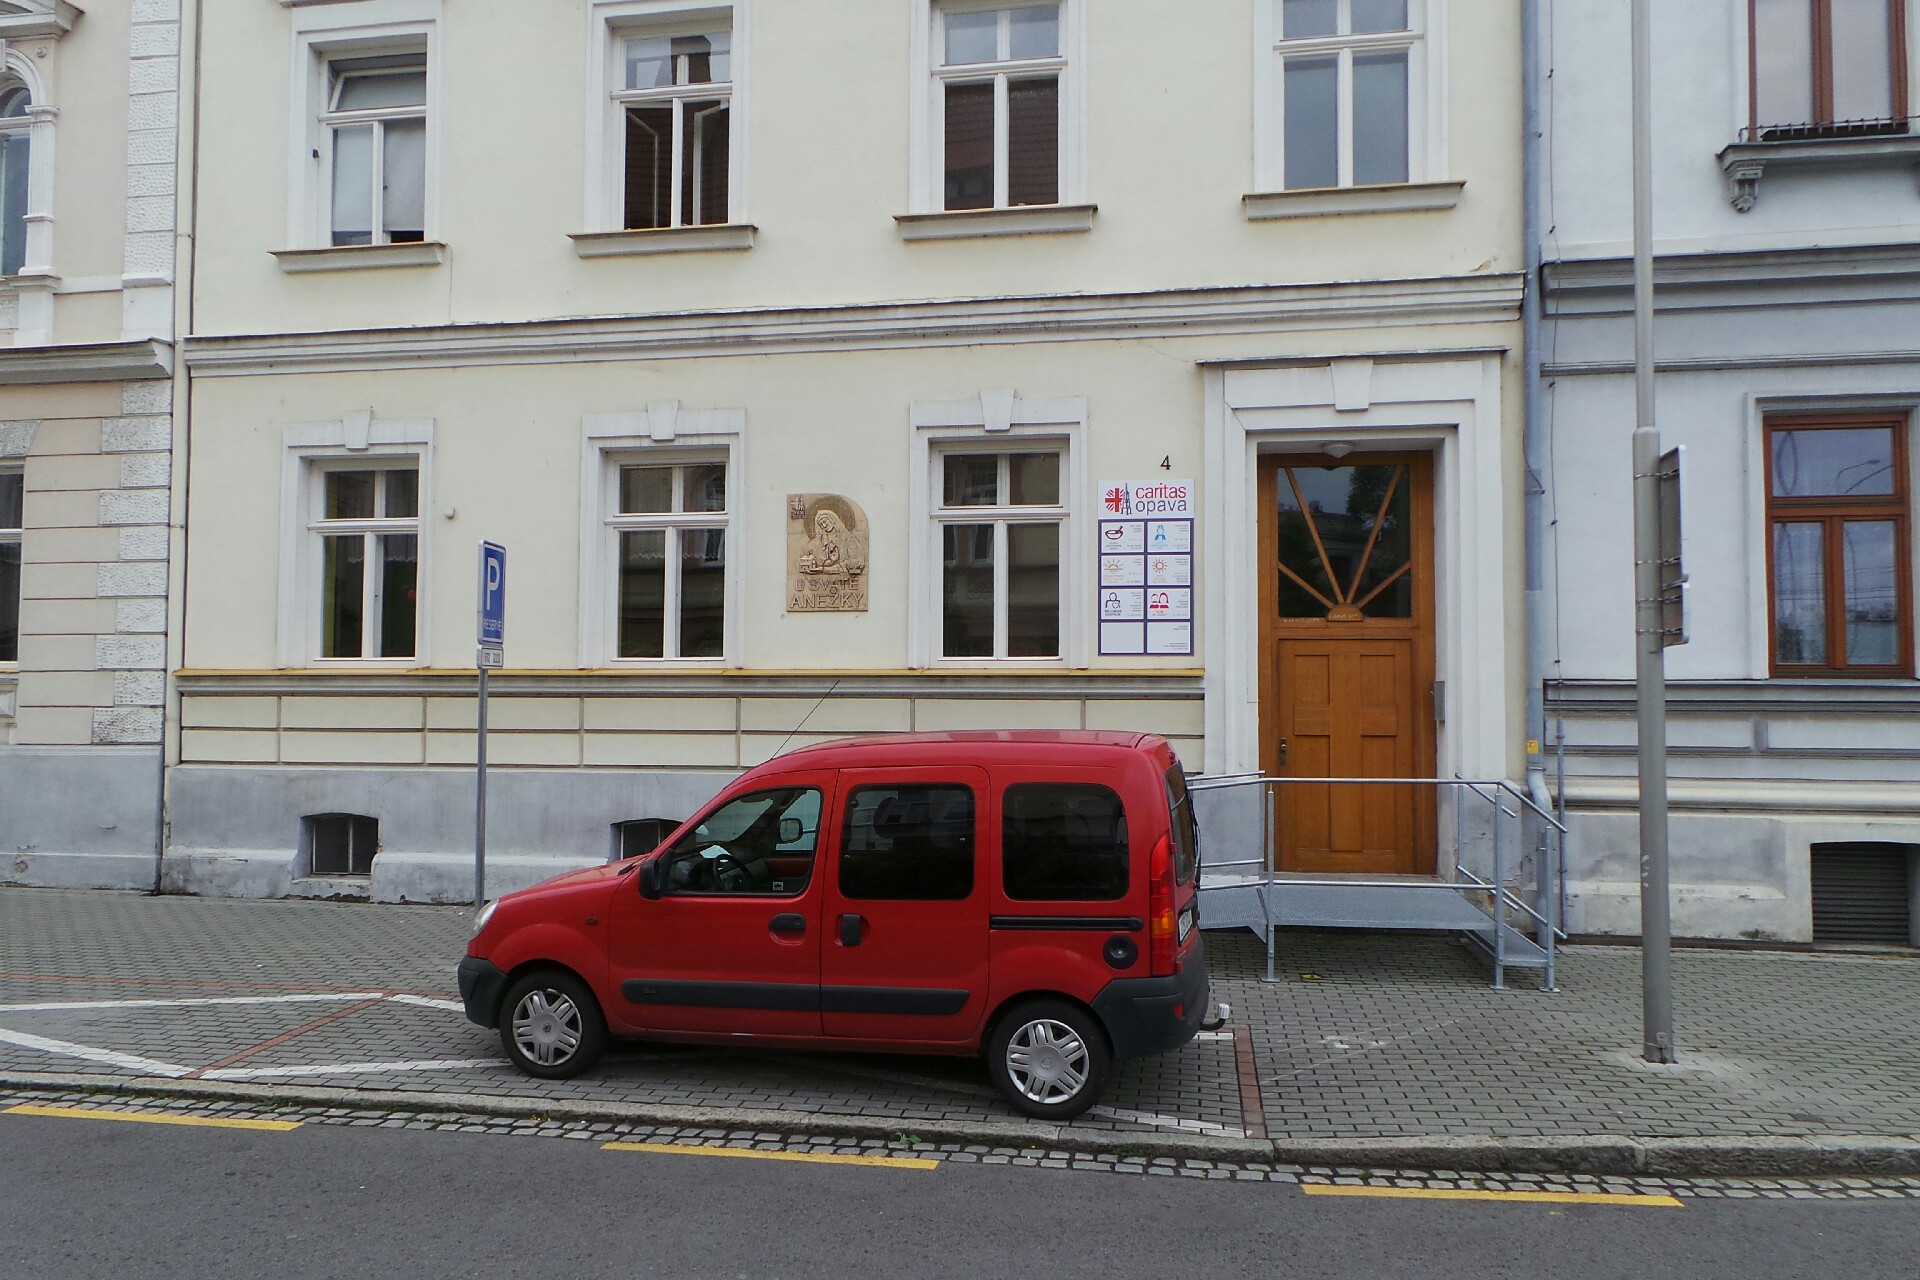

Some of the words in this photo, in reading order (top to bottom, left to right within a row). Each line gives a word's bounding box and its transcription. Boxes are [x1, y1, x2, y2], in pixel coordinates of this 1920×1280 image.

[1160, 455, 1171, 470] 4
[1135, 482, 1186, 499] caritas
[1135, 500, 1187, 516] opava
[486, 557, 500, 611] P
[795, 578, 806, 592] U
